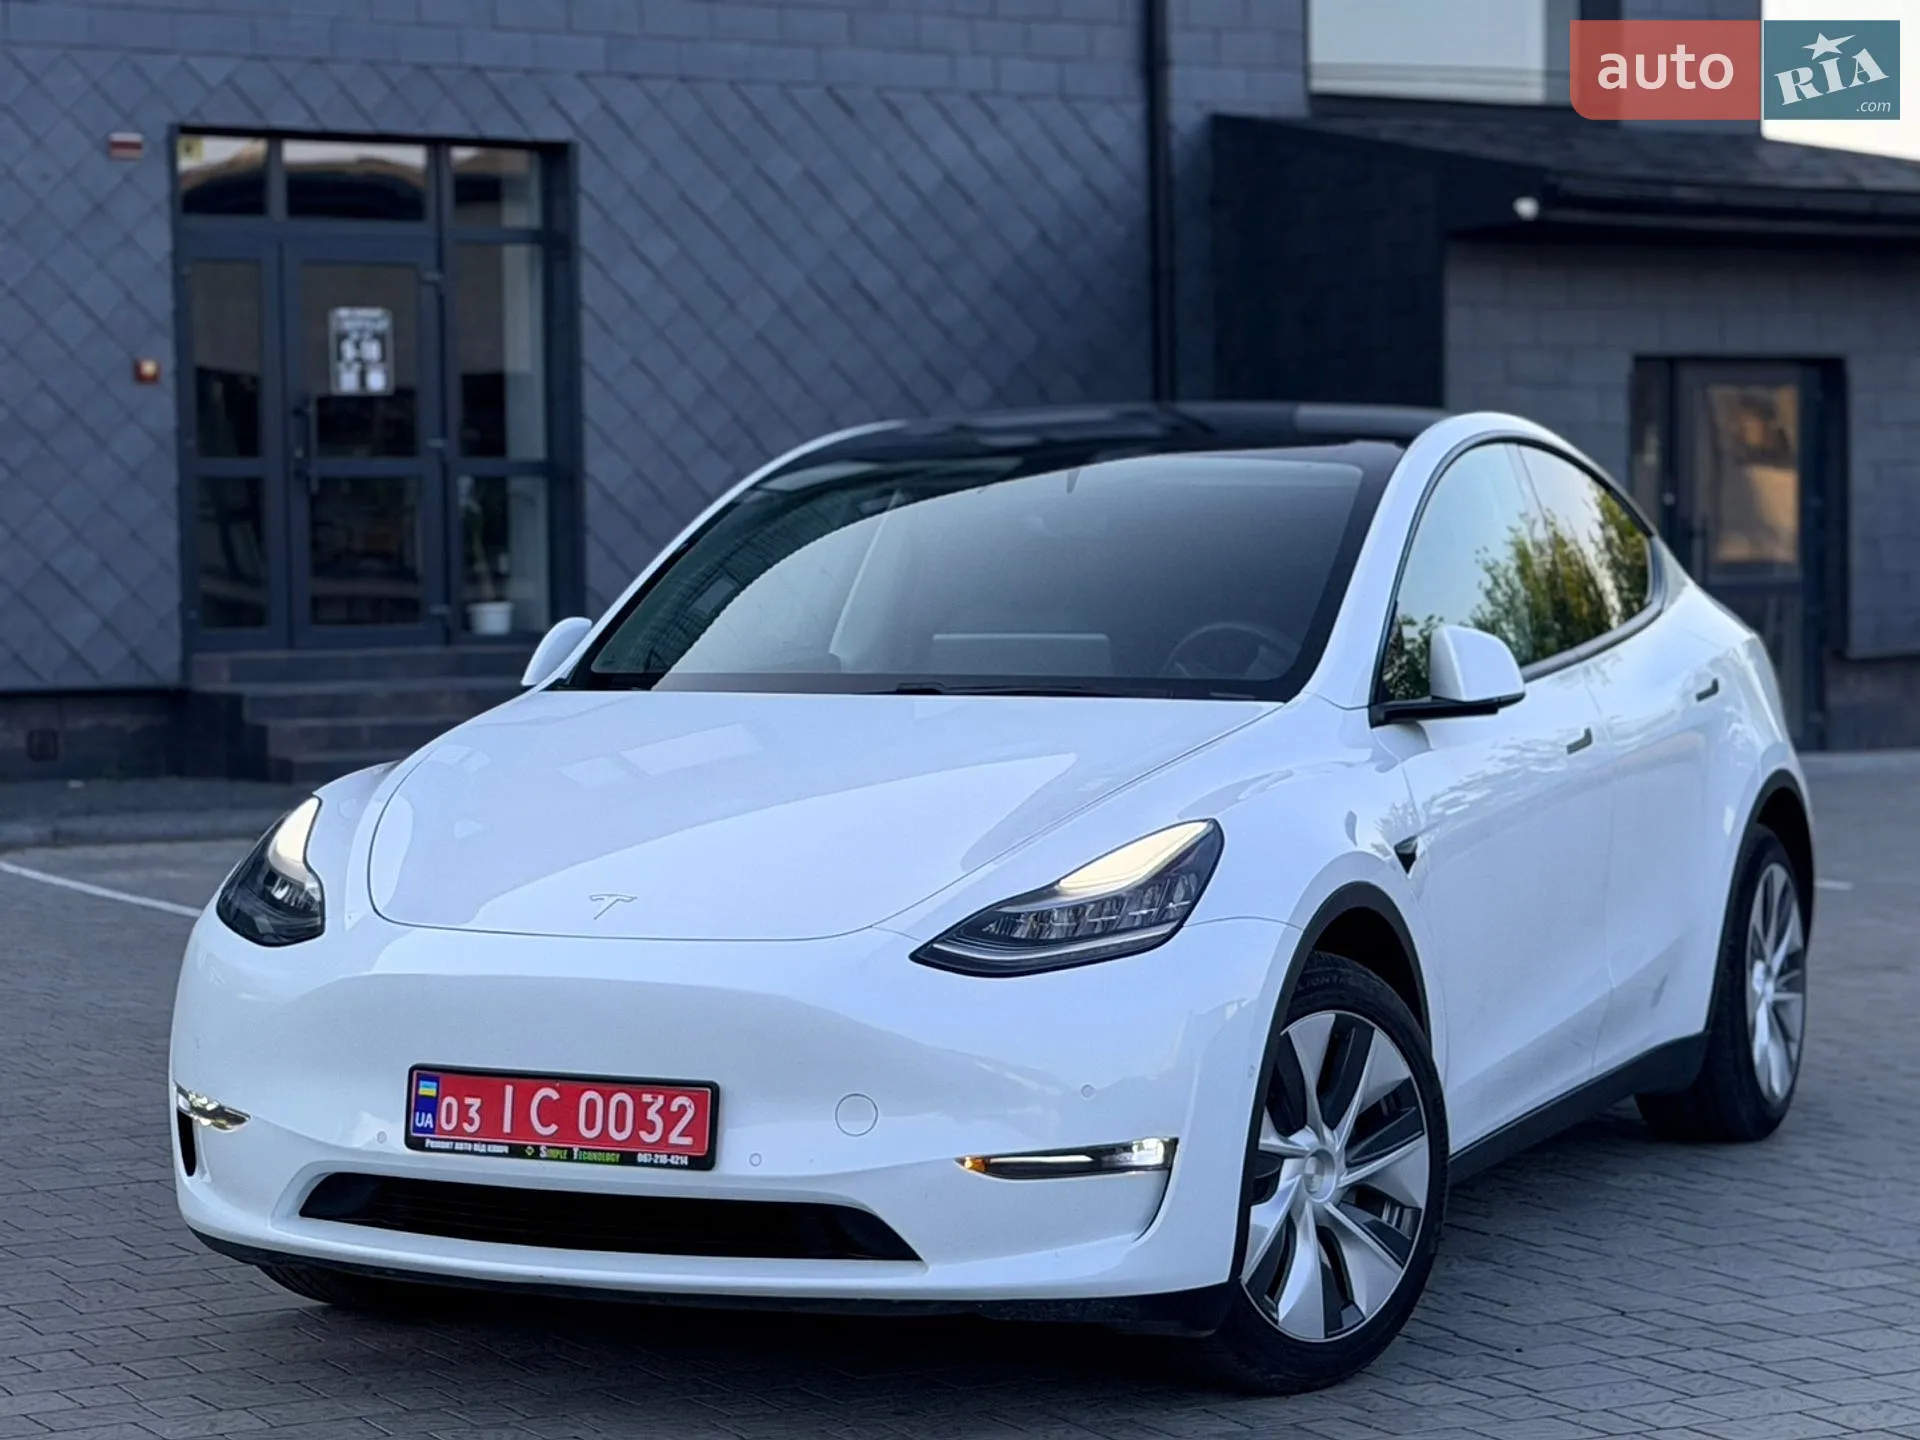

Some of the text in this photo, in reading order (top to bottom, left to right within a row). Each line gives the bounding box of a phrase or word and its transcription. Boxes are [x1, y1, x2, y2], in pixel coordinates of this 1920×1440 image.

[415, 1111, 434, 1129] UA
[440, 1096, 482, 1133] 03
[578, 1090, 695, 1146] 0032
